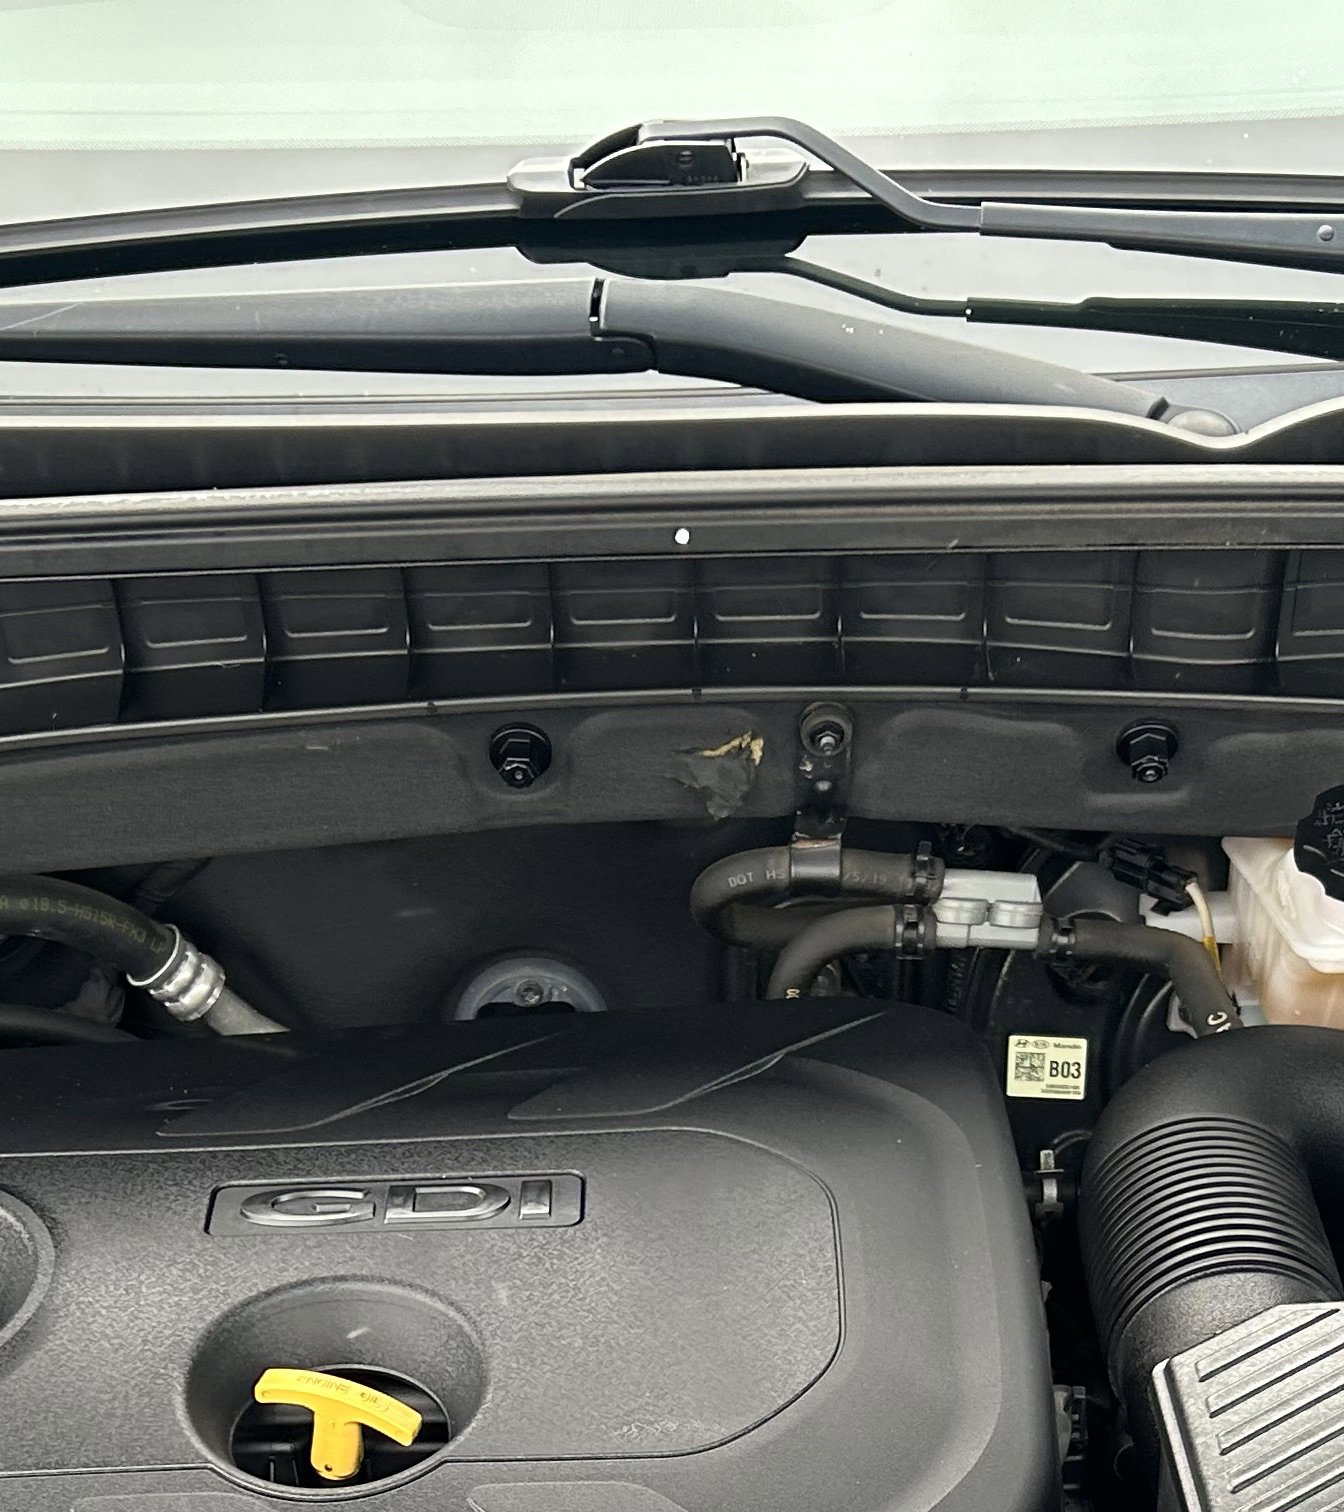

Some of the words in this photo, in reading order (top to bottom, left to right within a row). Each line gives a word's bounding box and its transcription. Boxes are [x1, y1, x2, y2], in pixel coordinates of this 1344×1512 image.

[728, 872, 753, 887] DOT
[1049, 1060, 1081, 1079] B03
[240, 1180, 552, 1227] GDI
